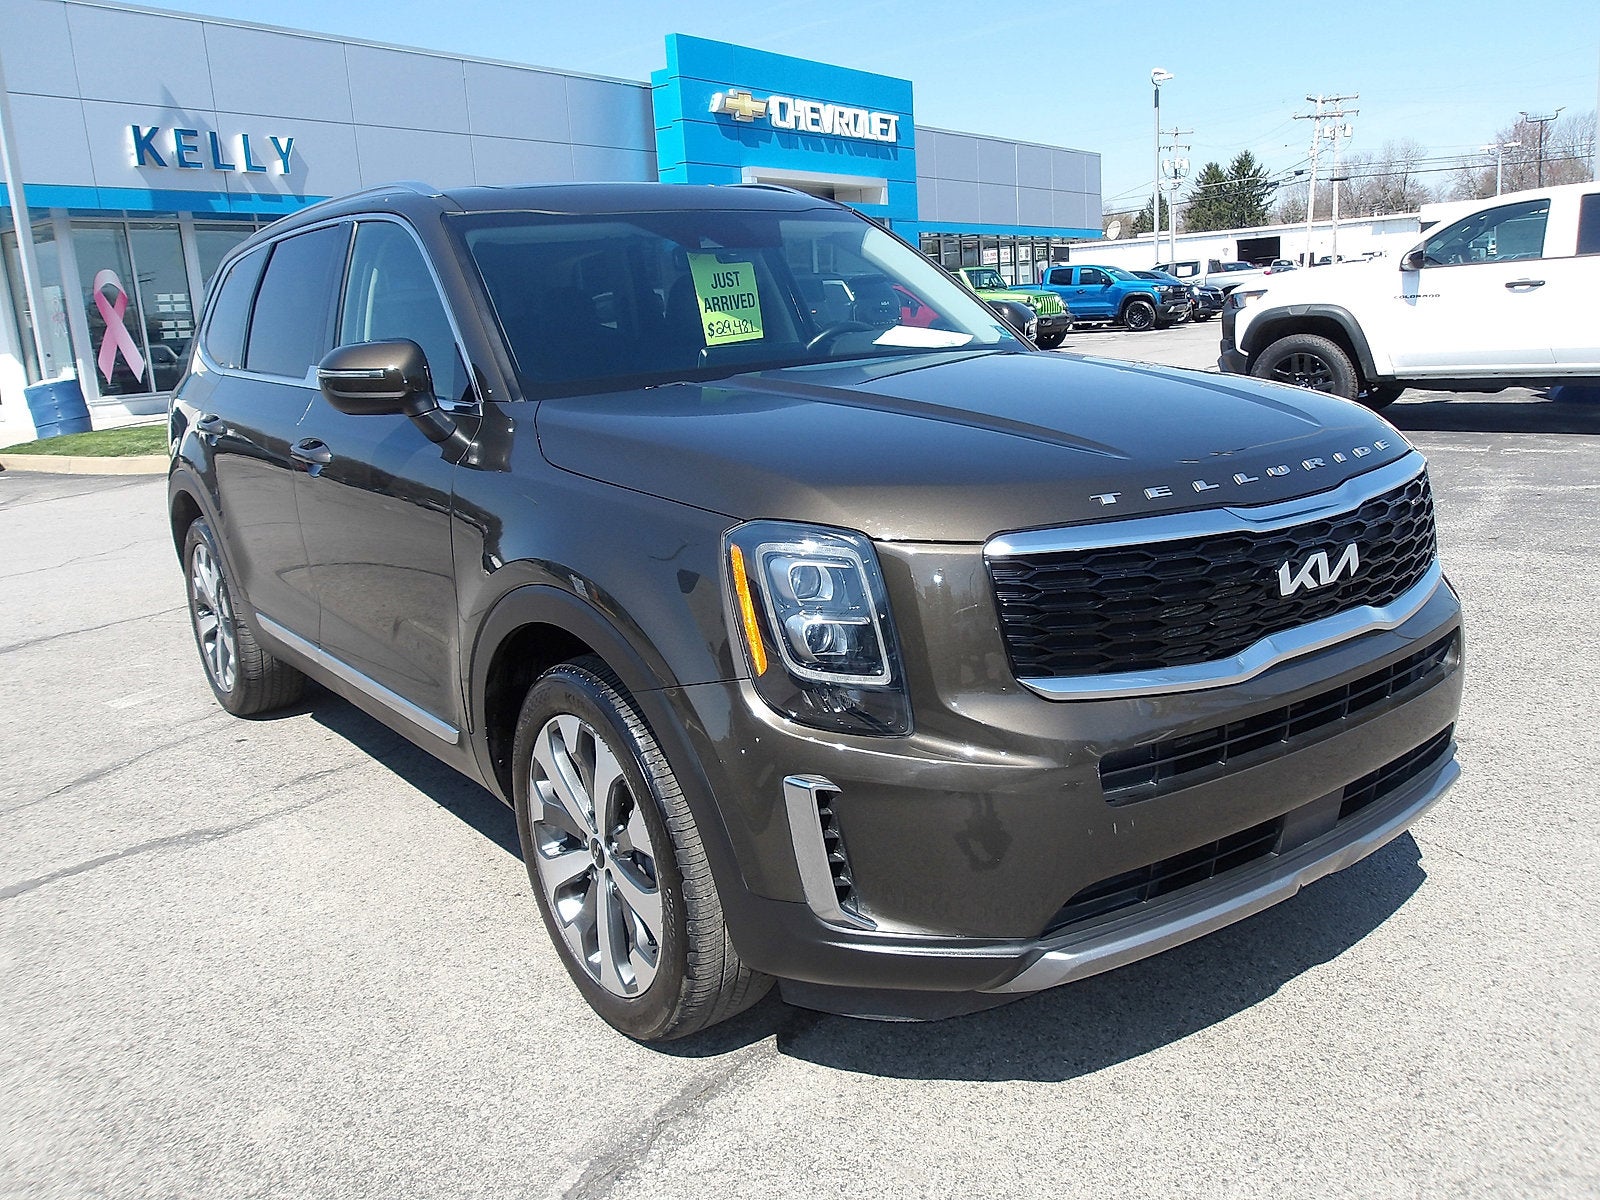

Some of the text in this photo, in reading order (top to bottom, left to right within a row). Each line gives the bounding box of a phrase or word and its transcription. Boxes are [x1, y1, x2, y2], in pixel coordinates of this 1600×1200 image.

[768, 95, 900, 143] CHEVROLET
[128, 124, 295, 175] KELLY
[704, 292, 756, 313] ARRIVED
[711, 271, 740, 289] JUST
[1089, 439, 1390, 505] TELLURIDE
[1277, 542, 1360, 597] KIA
